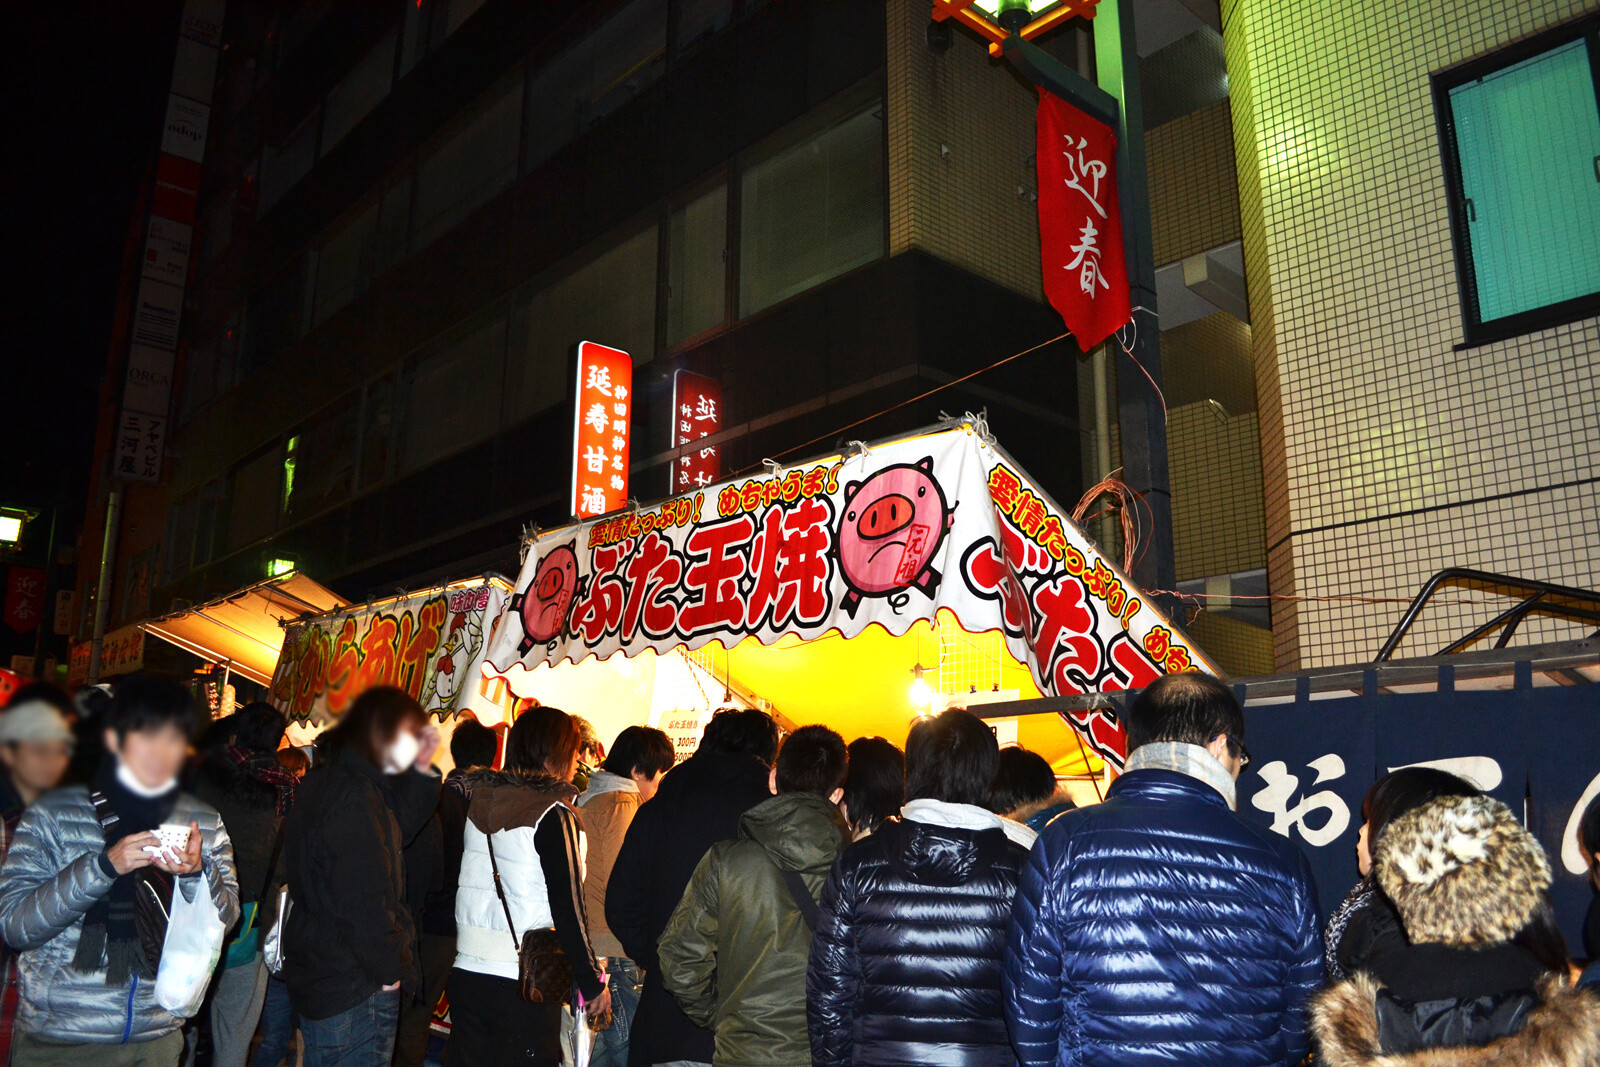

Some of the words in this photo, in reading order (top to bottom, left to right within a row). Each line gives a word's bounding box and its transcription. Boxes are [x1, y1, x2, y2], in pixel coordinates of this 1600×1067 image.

[1063, 134, 1109, 300] 迎春
[130, 368, 168, 385] ORCA
[121, 417, 141, 474] 三河屋
[581, 364, 613, 515] 延寿甘酒
[610, 384, 628, 491] 神田明神名物
[589, 494, 704, 548] 愛情たっぷり!
[718, 463, 843, 515] めちゃうま!
[572, 498, 832, 646] ぶた玉焼
[899, 529, 924, 580] 元祖
[988, 465, 1140, 630] 愛情たっぷり!
[1143, 625, 1198, 674] めち
[12, 576, 38, 620] 迎春
[291, 596, 446, 718] からあげ
[668, 719, 698, 730] ぶた玉焼き
[677, 736, 697, 748] 300円
